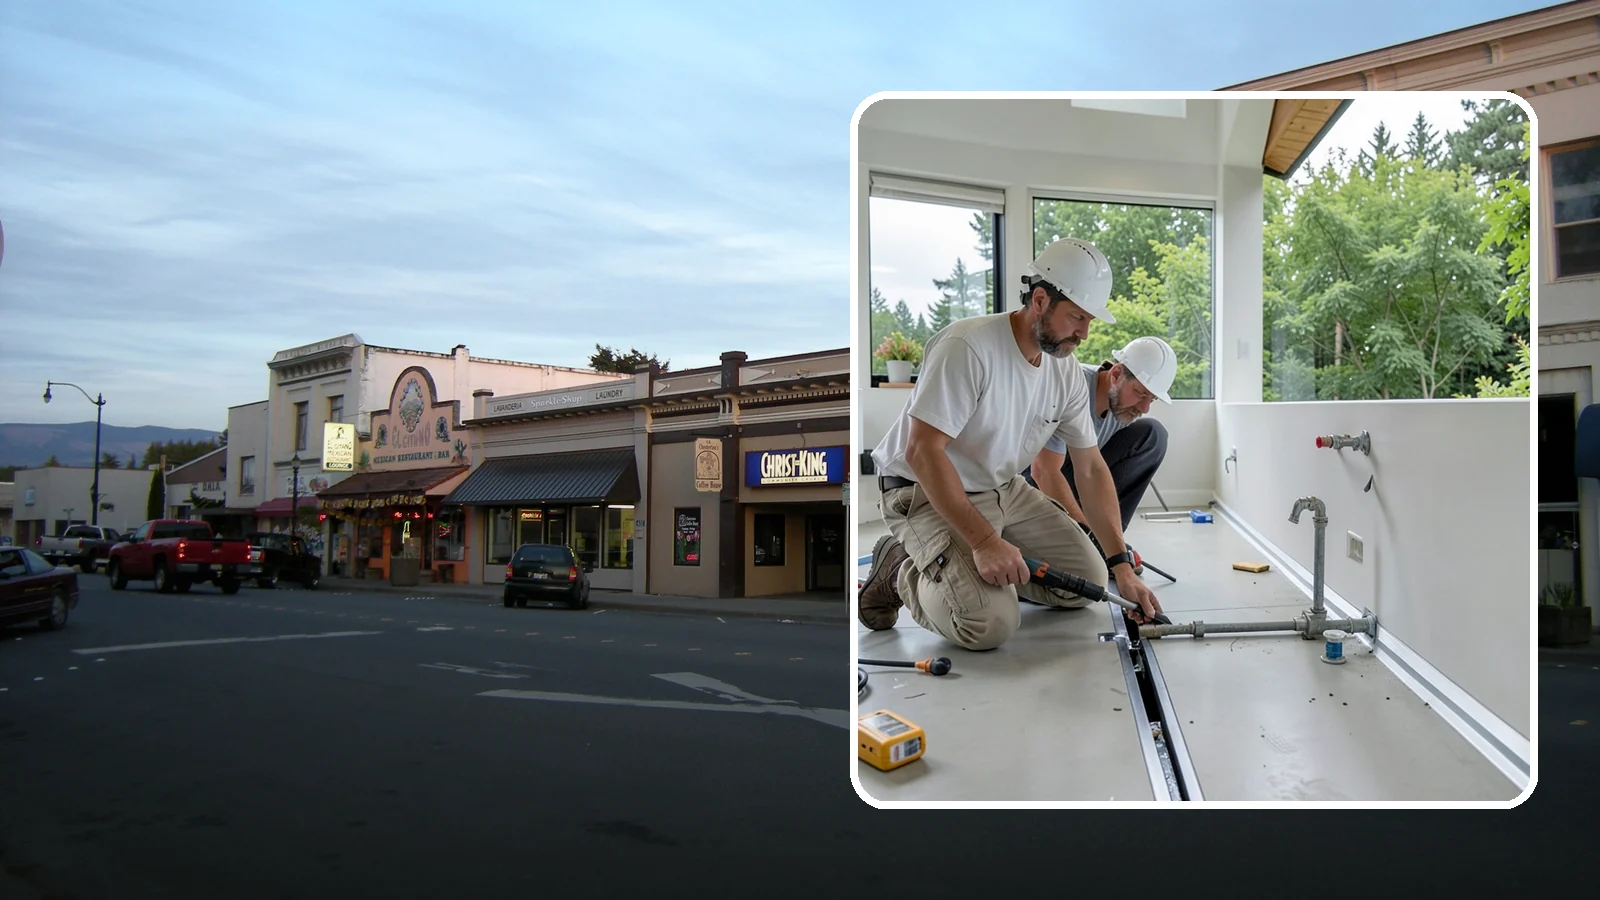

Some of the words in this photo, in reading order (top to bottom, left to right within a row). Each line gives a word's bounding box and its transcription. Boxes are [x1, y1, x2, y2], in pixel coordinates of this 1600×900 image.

[531, 396, 561, 409] Sparkle
[561, 393, 583, 404] Shop
[595, 388, 624, 400] LAUNDRY
[391, 425, 402, 449] EL
[374, 455, 396, 464] MEXICAN
[397, 451, 433, 463] RESTAURANT
[437, 449, 450, 459] BAR
[760, 452, 798, 478] CHRIST
[799, 450, 828, 477] KING
[696, 480, 709, 489] Coffee
[710, 480, 722, 489] House
